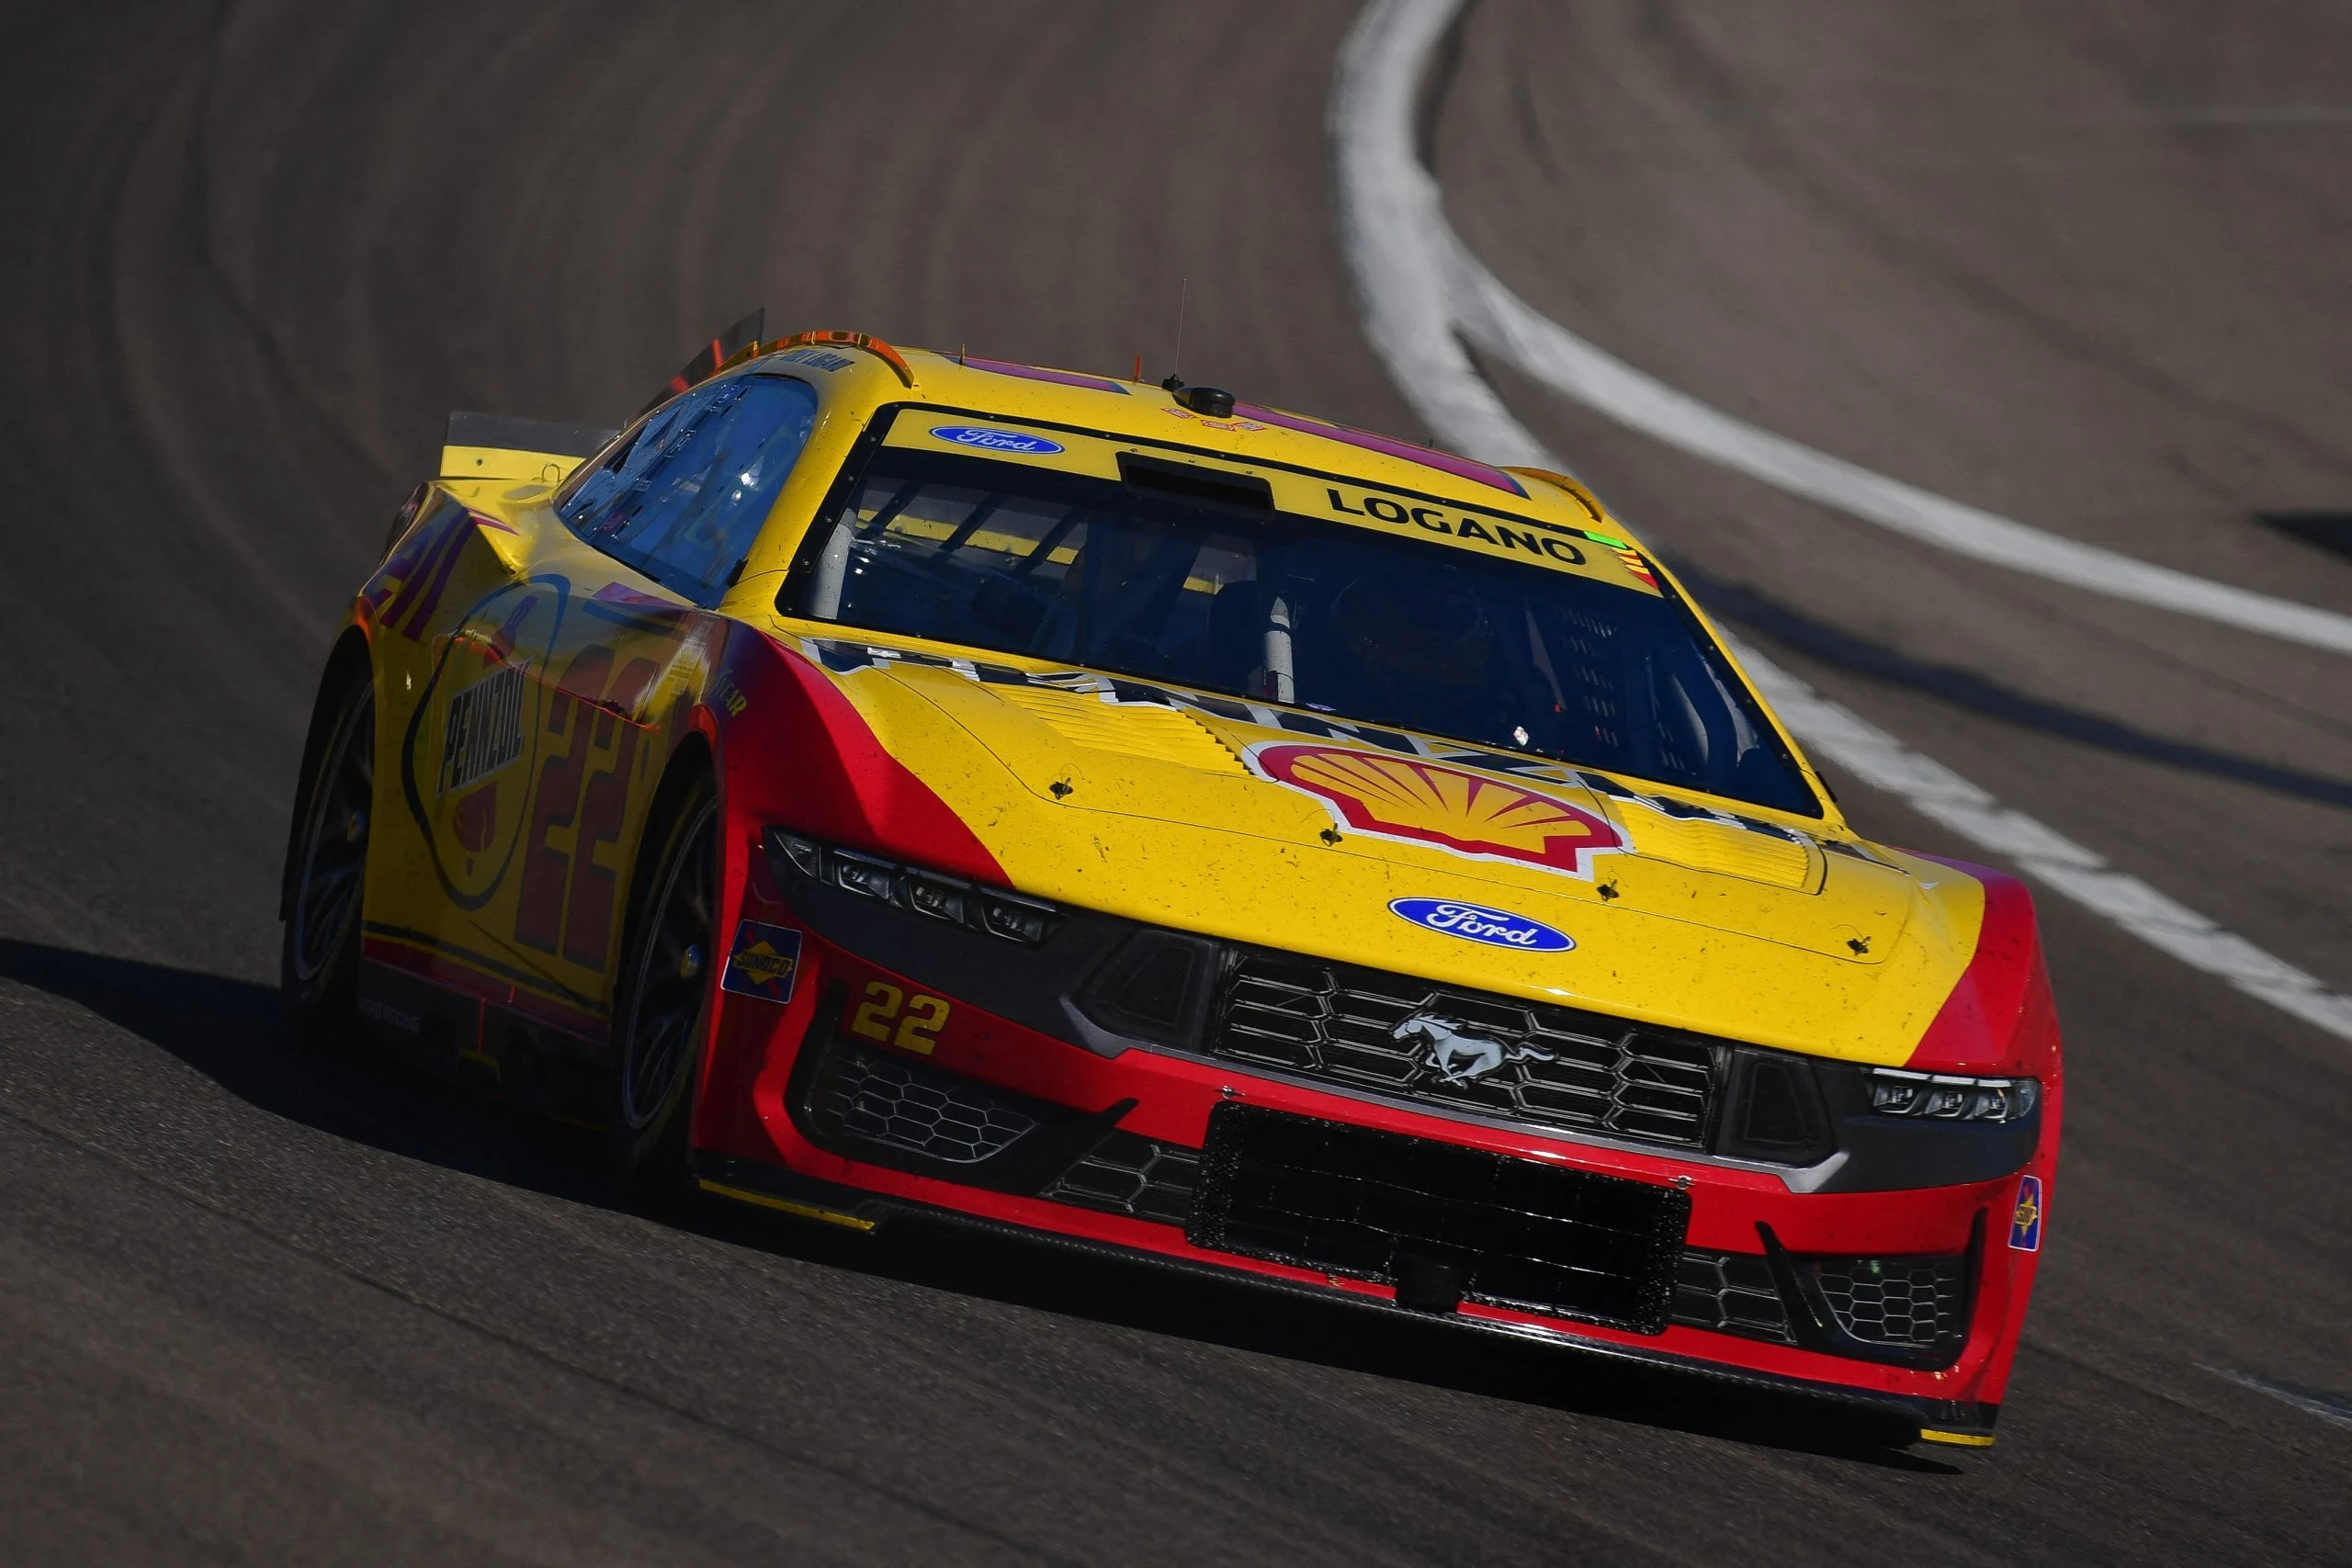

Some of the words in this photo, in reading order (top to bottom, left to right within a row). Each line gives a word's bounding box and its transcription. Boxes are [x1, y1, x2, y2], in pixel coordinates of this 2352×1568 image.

[956, 429, 1037, 451] Ford
[1327, 488, 1587, 566] LOGANO
[514, 643, 661, 974] 22
[1426, 904, 1538, 945] Ford
[734, 952, 794, 977] SUNOCO
[851, 980, 951, 1057] 22
